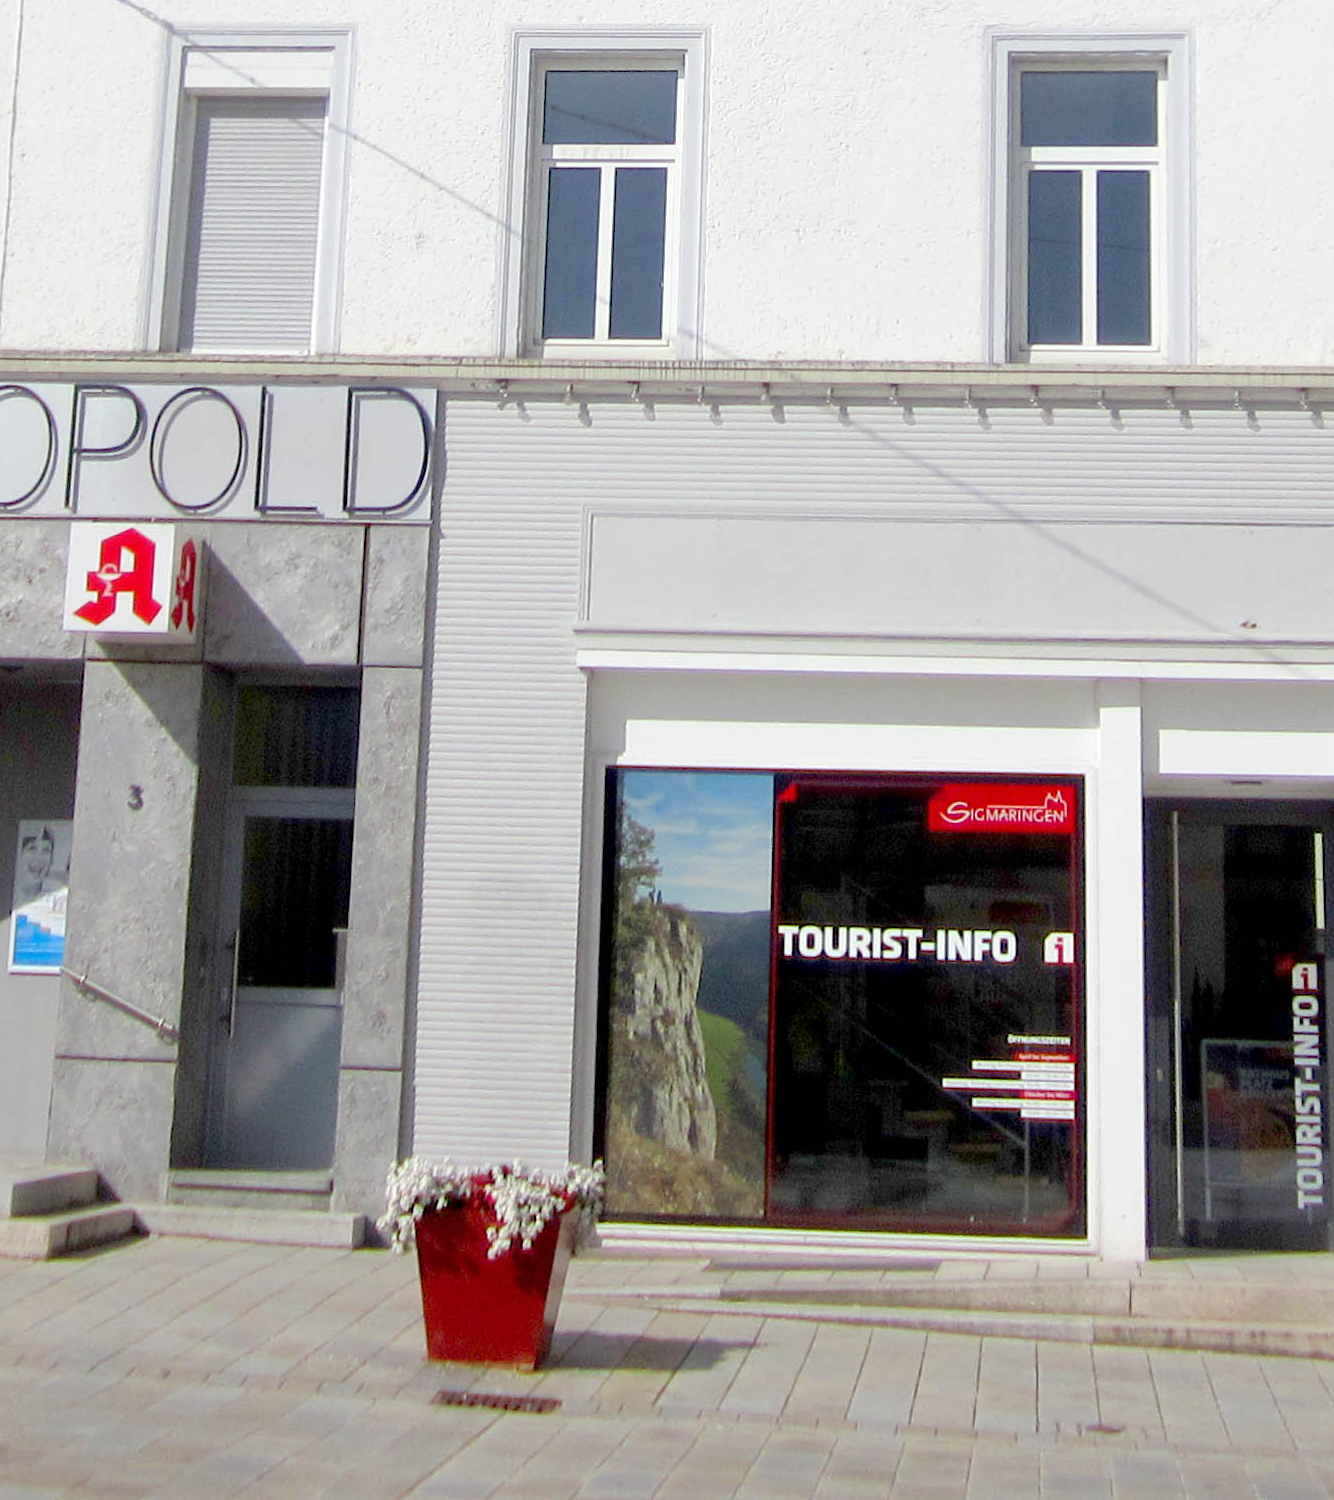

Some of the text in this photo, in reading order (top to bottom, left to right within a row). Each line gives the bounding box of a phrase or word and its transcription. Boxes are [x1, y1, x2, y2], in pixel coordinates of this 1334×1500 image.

[127, 785, 144, 811] 3
[939, 801, 1065, 824] SIGMARINGEN
[777, 924, 1017, 964] TOURIST-INFO
[1292, 995, 1324, 1210] TOURIST-INFO
